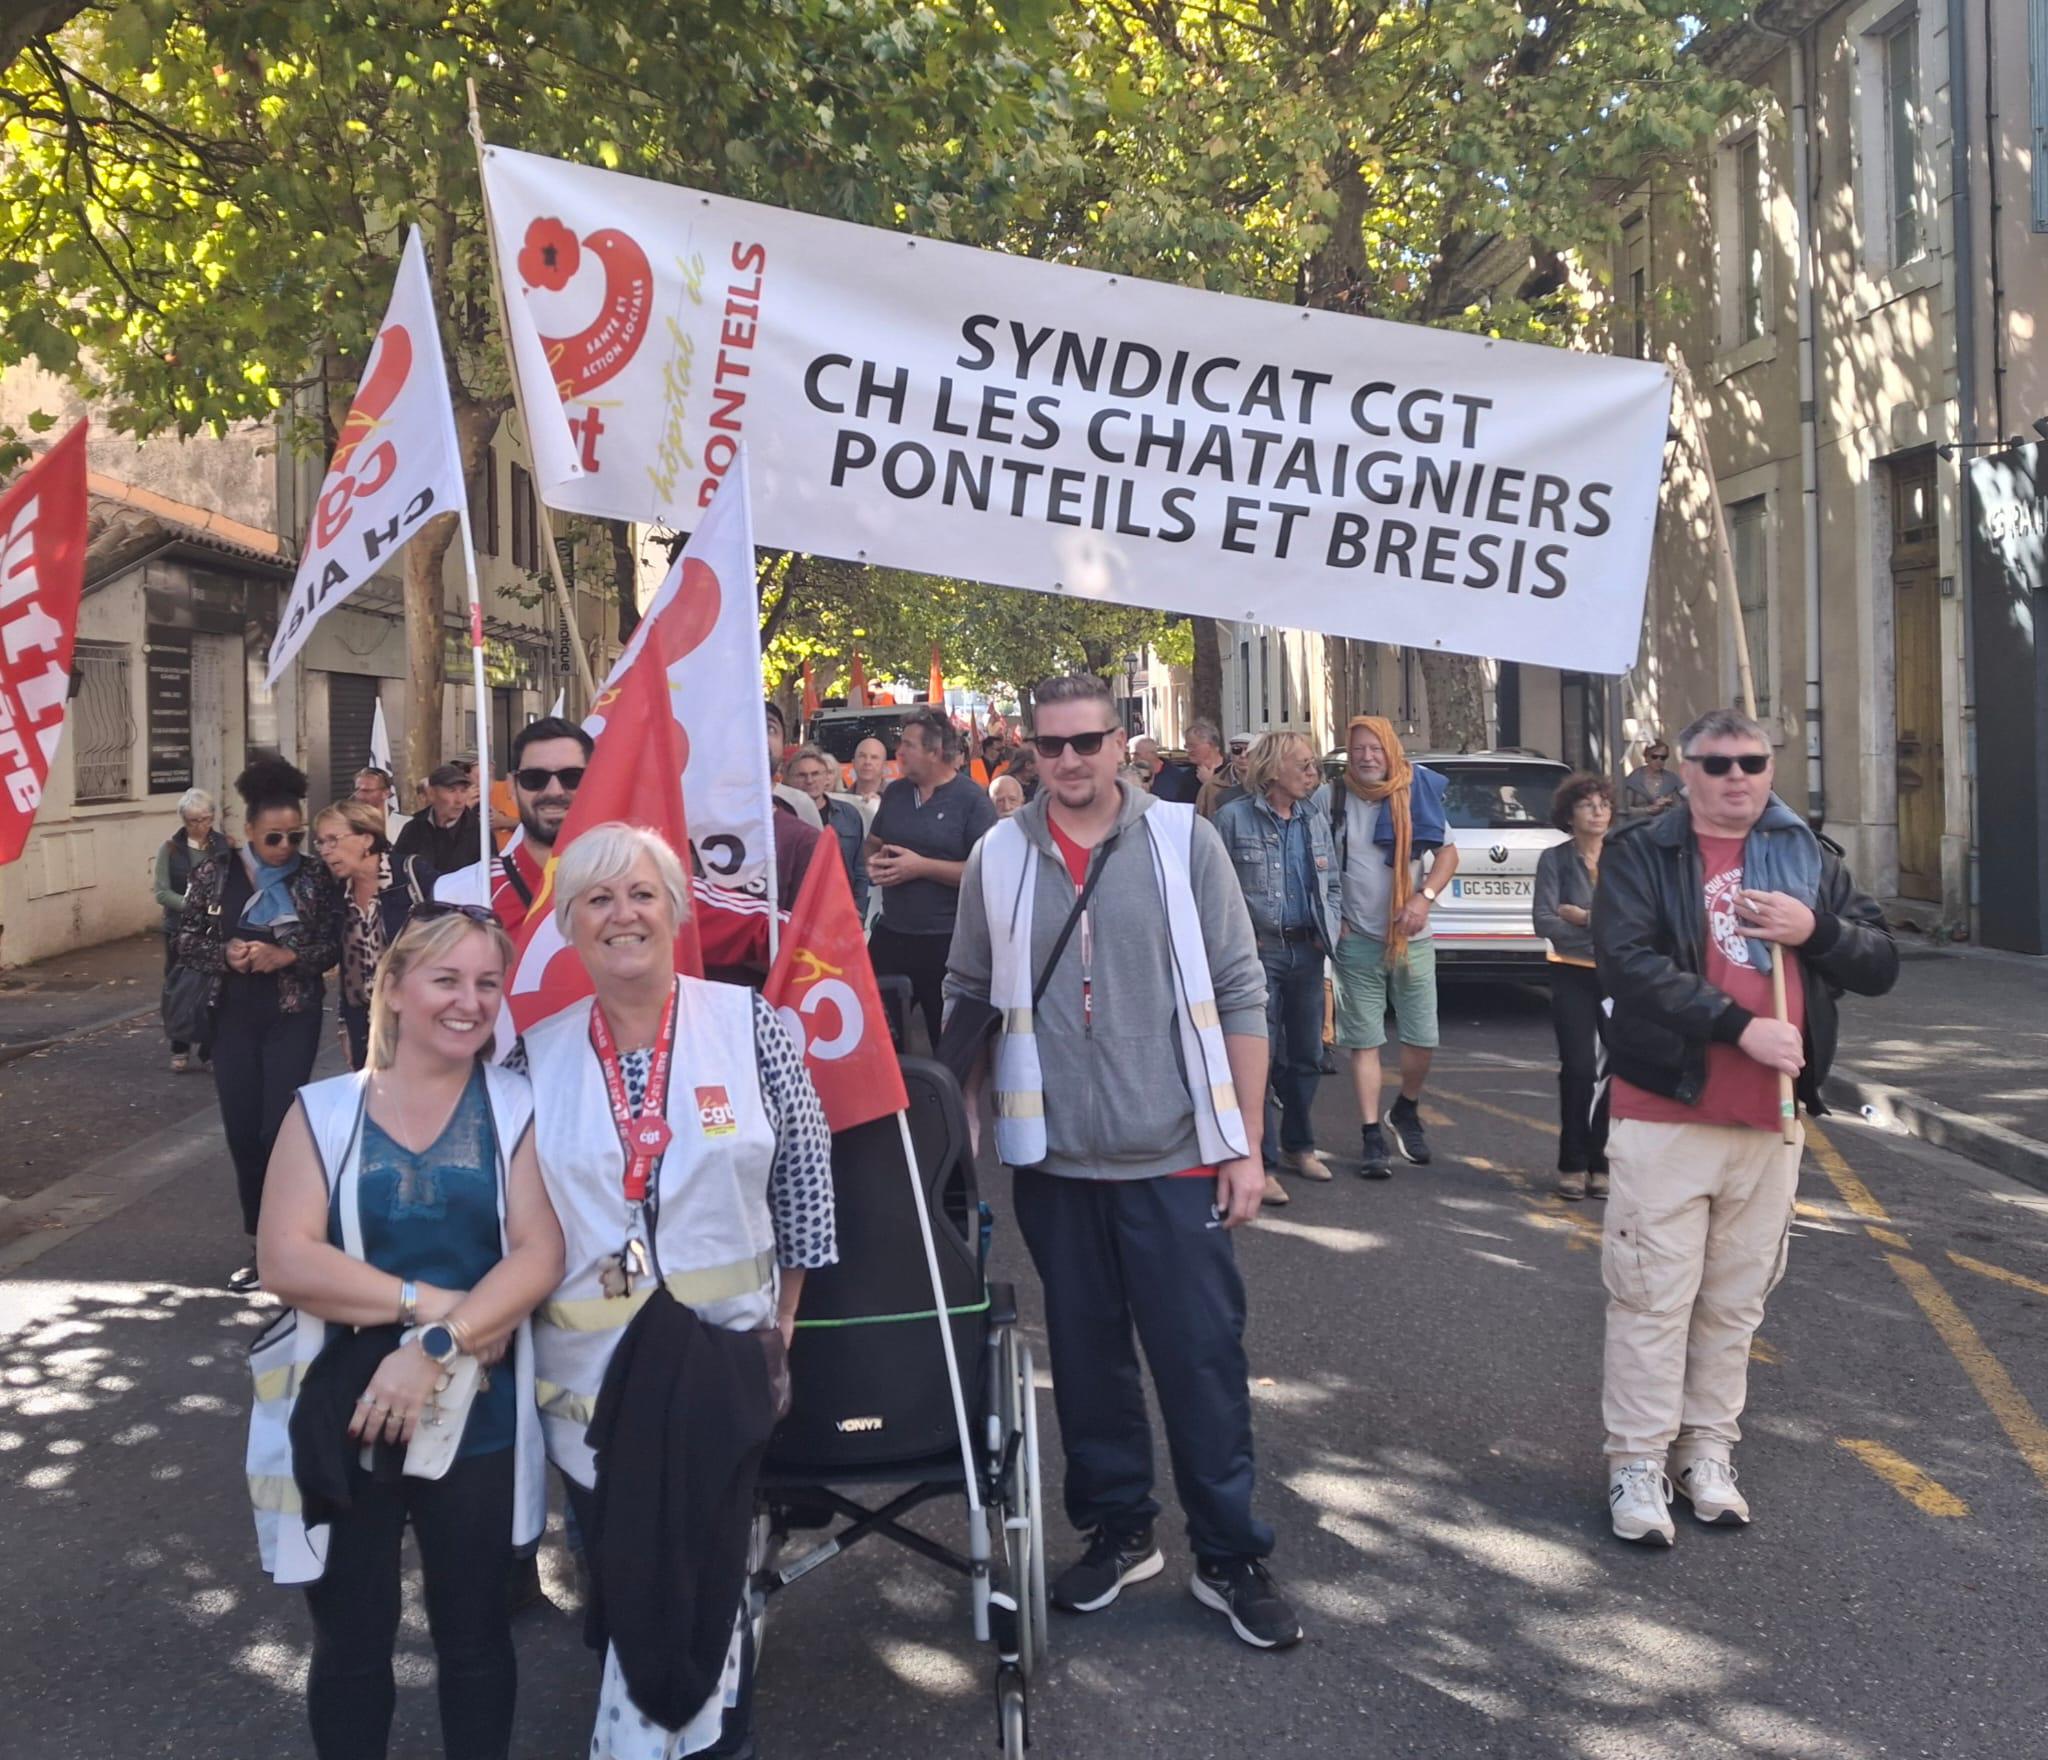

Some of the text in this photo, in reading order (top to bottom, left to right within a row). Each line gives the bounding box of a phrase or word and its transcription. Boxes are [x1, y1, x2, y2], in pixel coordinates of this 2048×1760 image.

[582, 342, 623, 379] ACTION
[621, 279, 643, 343] SOCIALE
[697, 241, 766, 507] PONTEILS
[957, 314, 1493, 449] SYNDICAT CGT
[804, 353, 1613, 537] CH LES CHATAIGNIERS
[830, 429, 1570, 600] PONTEILS ET BRESIS
[1463, 881, 1531, 896] GC-536-ZX
[639, 1129, 661, 1146] cgt
[700, 1103, 735, 1125] cgt
[836, 1416, 884, 1433] VONYX
